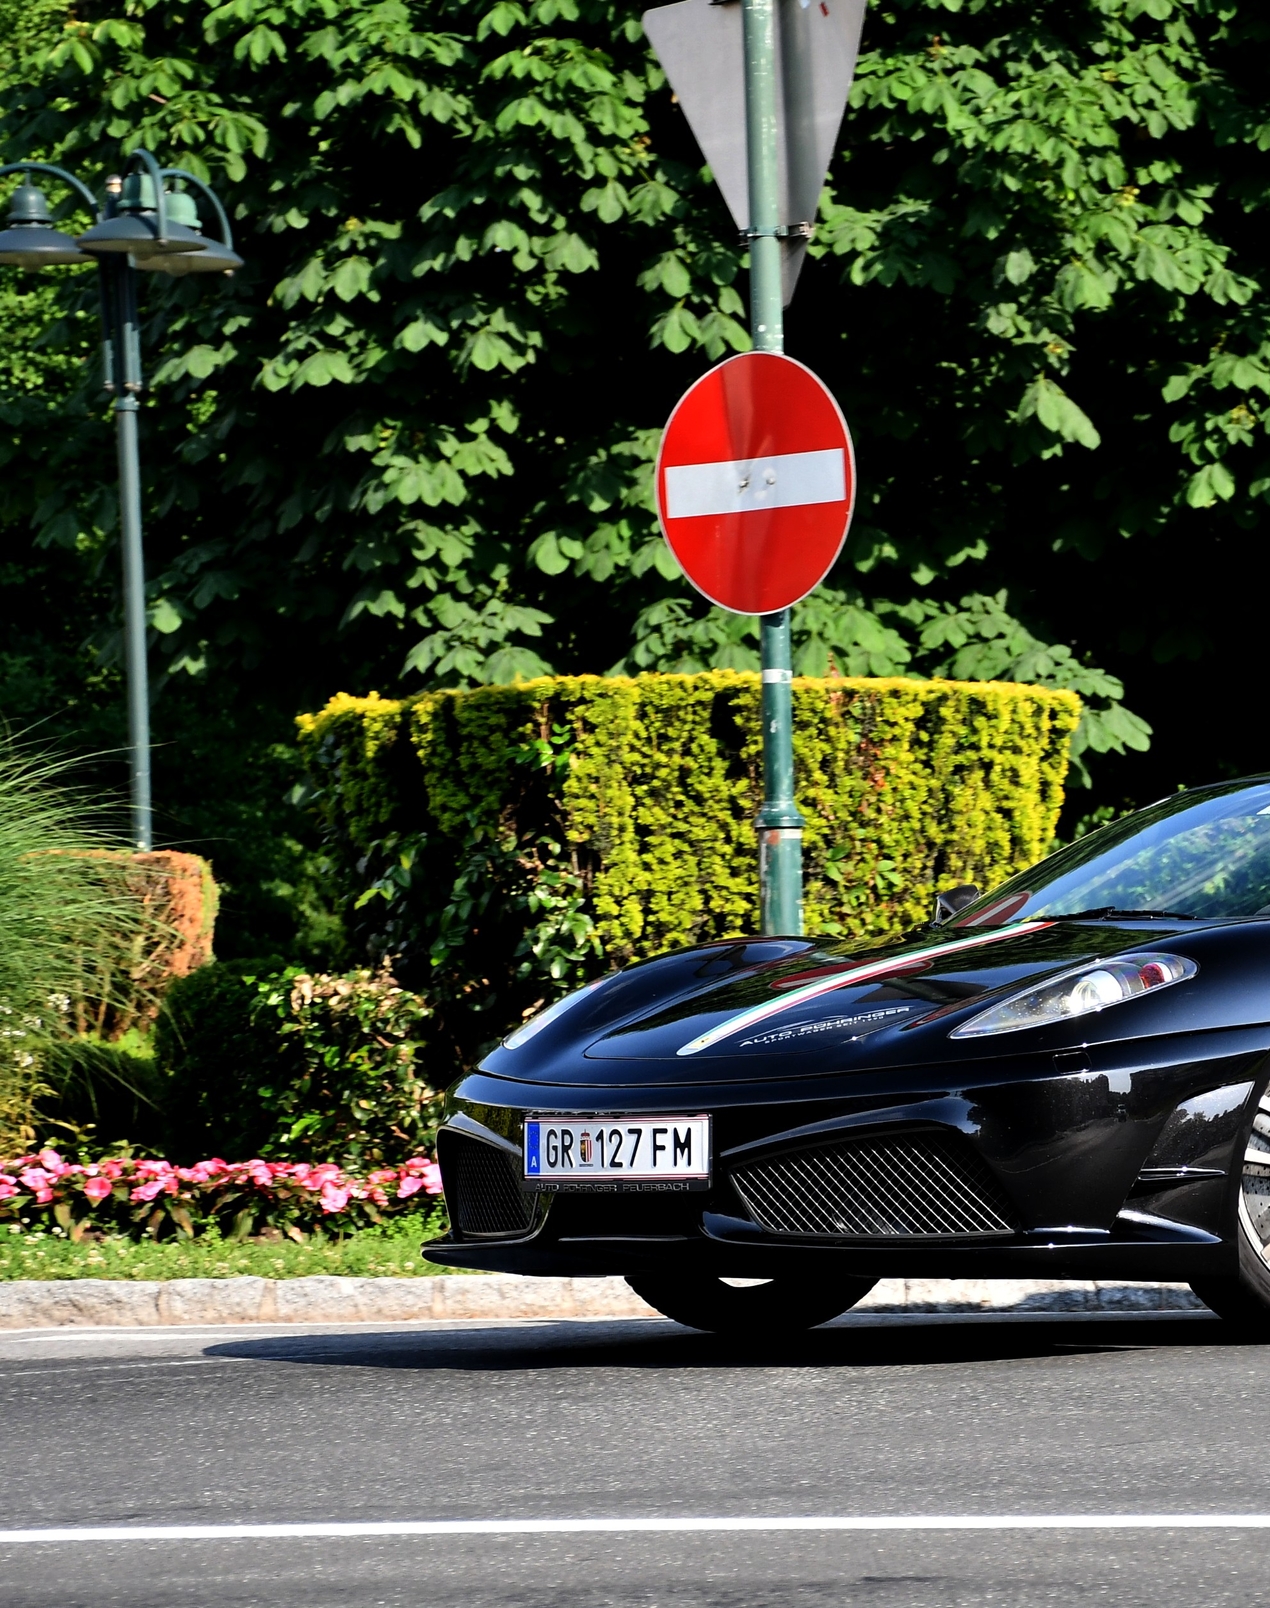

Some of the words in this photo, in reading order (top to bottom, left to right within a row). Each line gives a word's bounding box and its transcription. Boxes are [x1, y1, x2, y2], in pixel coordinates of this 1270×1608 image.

[739, 1030, 793, 1048] AUTO
[546, 1128, 574, 1168] GR
[595, 1128, 643, 1168] 127
[652, 1127, 692, 1168] FM
[530, 1155, 538, 1168] A
